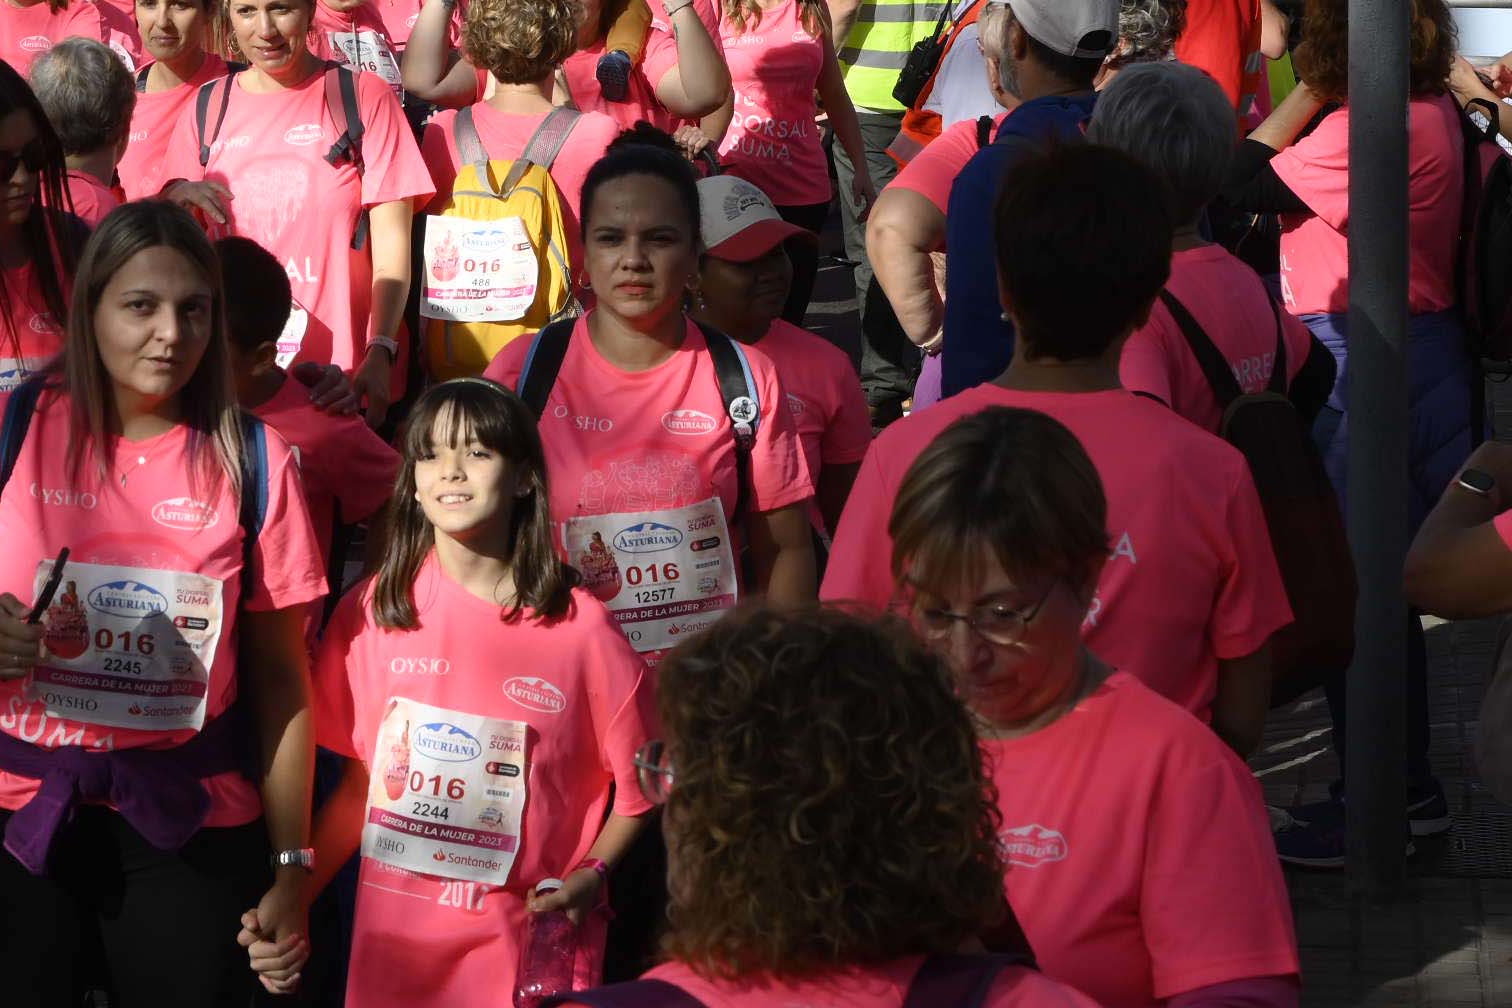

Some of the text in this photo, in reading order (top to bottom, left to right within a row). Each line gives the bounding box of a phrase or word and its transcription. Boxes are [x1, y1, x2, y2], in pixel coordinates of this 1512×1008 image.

[464, 259, 501, 273] 016
[554, 404, 613, 433] OSHO
[619, 535, 678, 548] ASTURIANA
[626, 562, 680, 586] 016
[93, 592, 162, 615] ASTURIANA
[176, 594, 210, 606] SUMA
[635, 587, 676, 604] 12577
[641, 609, 654, 619] DE
[655, 607, 668, 617] LA
[669, 602, 700, 614] MUJER
[94, 628, 155, 656] 016
[103, 657, 143, 676] 2245
[50, 672, 100, 689] CARRERA
[101, 677, 115, 689] DE
[117, 679, 132, 691] LA
[134, 681, 169, 695] MUJER
[45, 695, 98, 712] OYSHO
[507, 683, 562, 710] ASTURIANA
[143, 703, 194, 719] Santander
[417, 736, 476, 757] ASTURIANA
[489, 740, 521, 753] SUMA
[409, 770, 467, 800] 016
[412, 801, 449, 821] 2244
[379, 814, 408, 832] CARRERA
[408, 823, 423, 835] DE
[424, 825, 439, 837] LA
[440, 829, 476, 843] MUJER
[447, 852, 503, 873] Santander
